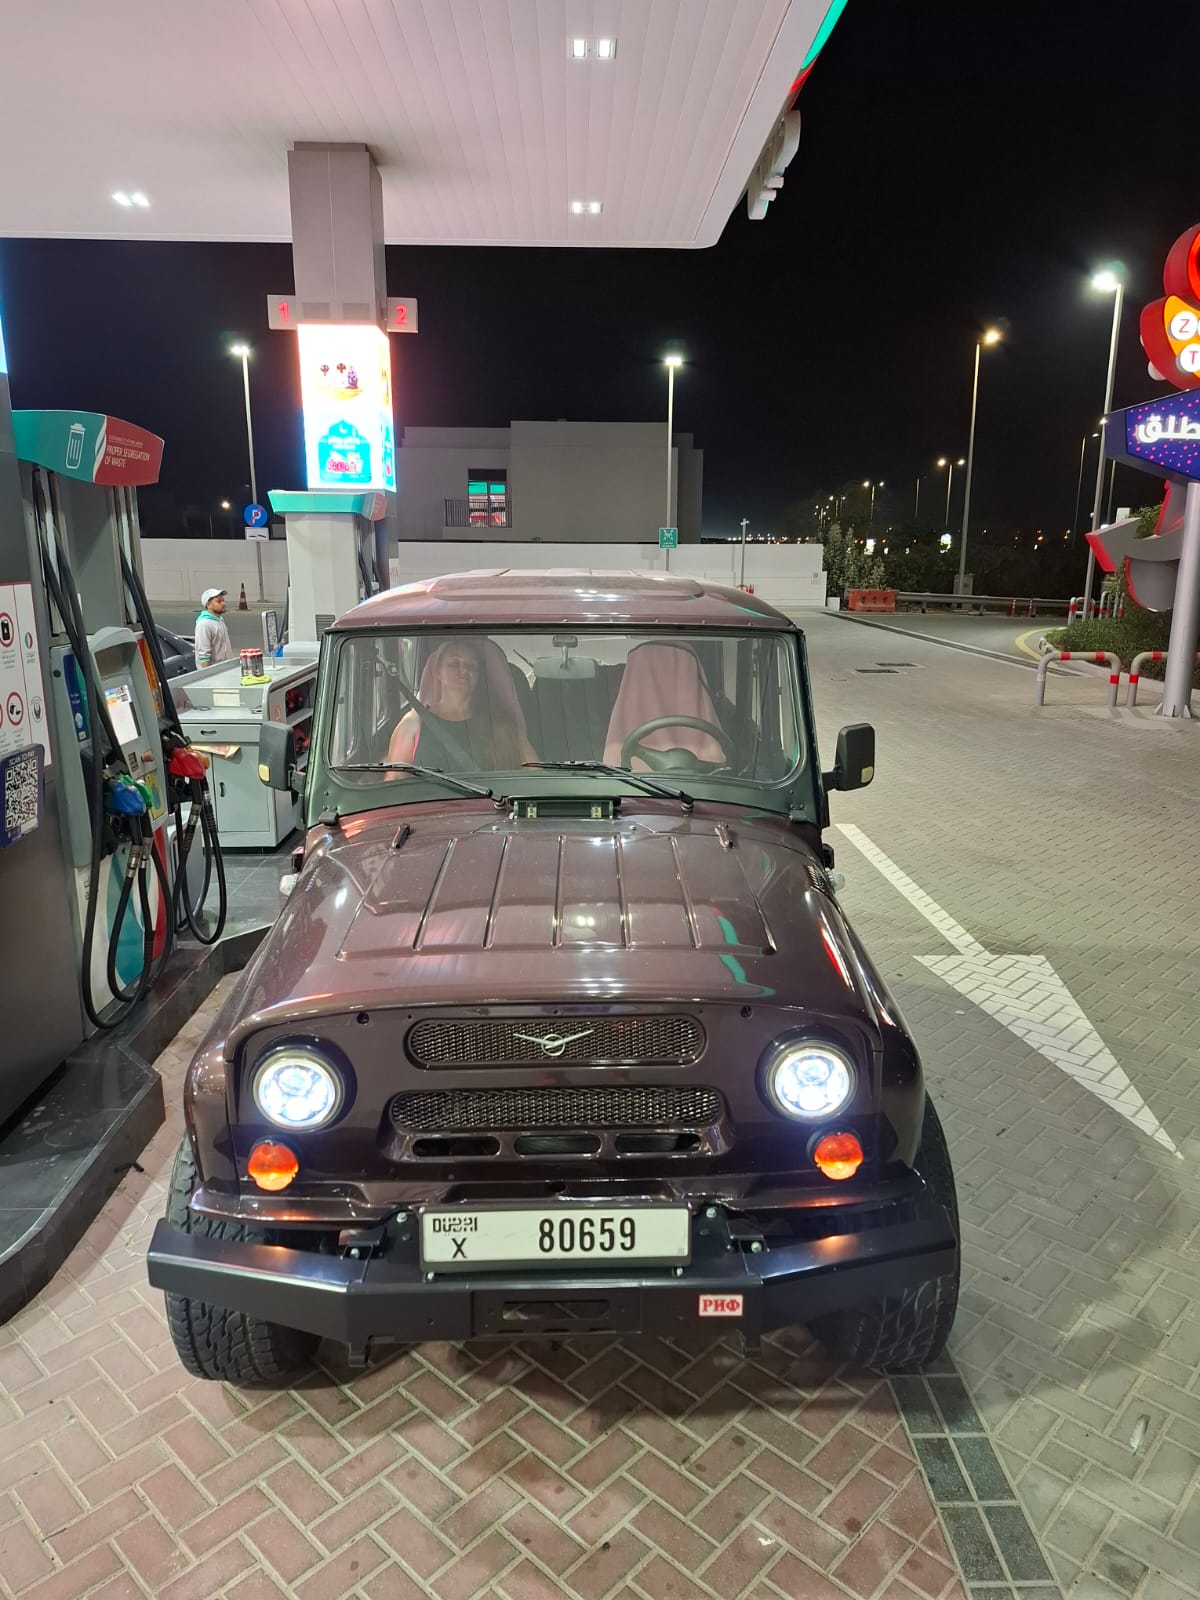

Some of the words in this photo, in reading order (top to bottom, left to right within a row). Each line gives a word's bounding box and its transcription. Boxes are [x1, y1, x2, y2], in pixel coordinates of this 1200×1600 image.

[277, 302, 290, 322] 1
[395, 304, 408, 325] 2
[106, 445, 123, 457] PROPER
[123, 448, 151, 462] SEGREGATION
[104, 456, 111, 465] OF
[111, 457, 126, 469] WASTE
[251, 509, 262, 525] P
[8, 756, 21, 767] SCAN
[21, 753, 28, 761] TO
[27, 750, 35, 759] PAY
[538, 1217, 636, 1253] 80659
[451, 1237, 467, 1259] X
[701, 1297, 741, 1313] РИФ
